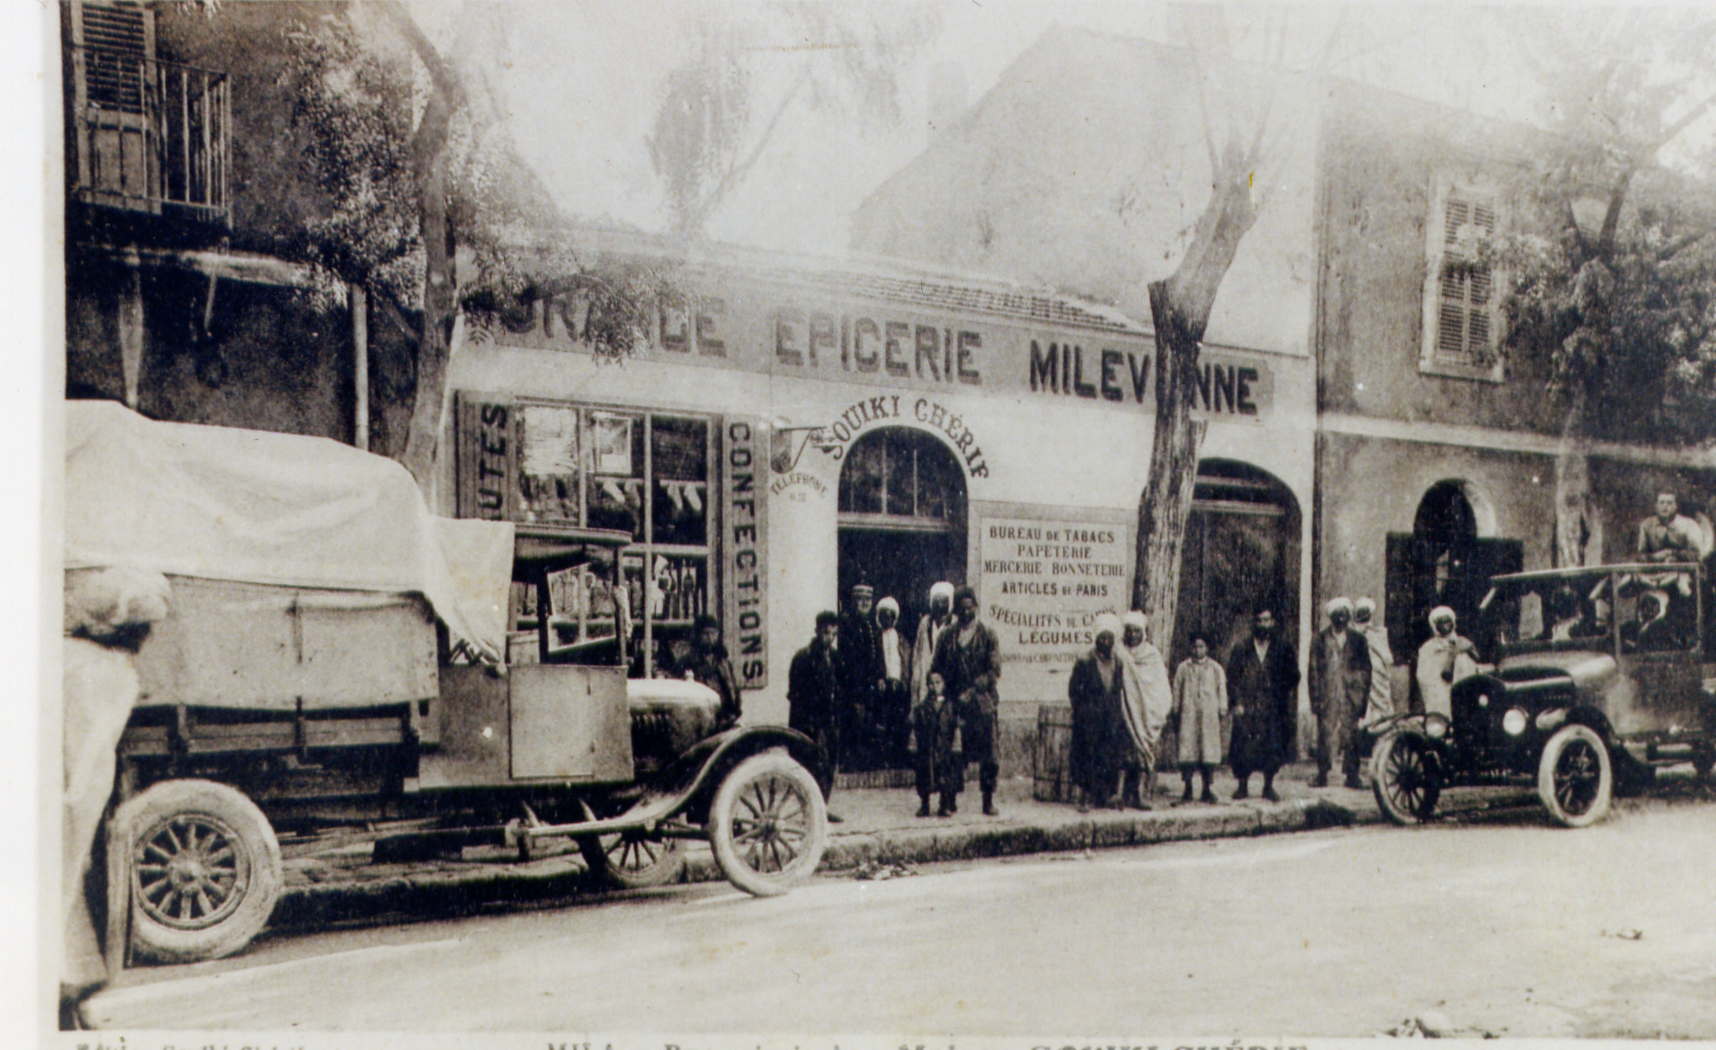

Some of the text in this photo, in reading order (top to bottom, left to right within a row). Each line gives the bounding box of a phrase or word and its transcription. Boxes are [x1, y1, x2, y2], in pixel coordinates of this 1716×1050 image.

[776, 311, 982, 384] EPICERIE
[1030, 339, 1256, 416] MILEVNNE
[915, 398, 989, 479] CHÉRIF
[989, 526, 1115, 543] BUREAU DE TABACS
[730, 422, 764, 681] CONFECTIONS
[1017, 544, 1092, 559] PAPETERIE
[984, 560, 1125, 577] MERCERIE BONNETERIE
[1002, 582, 1057, 595] ARTICLES
[1076, 584, 1108, 597] PARIS
